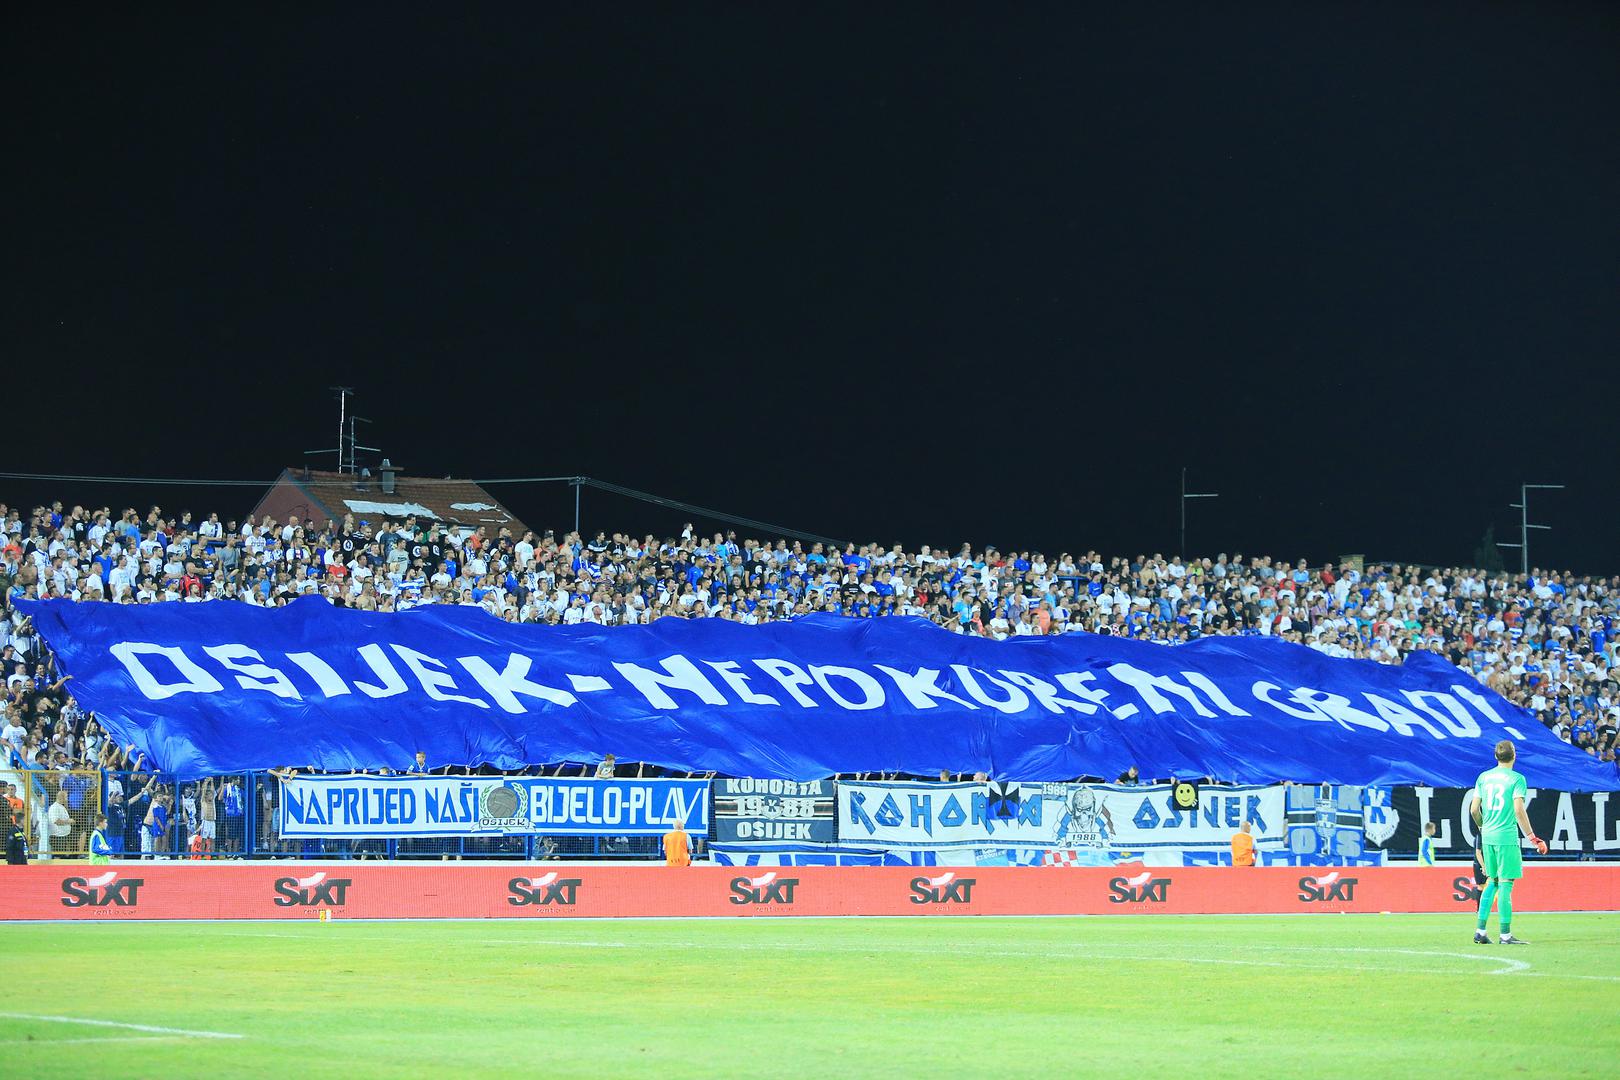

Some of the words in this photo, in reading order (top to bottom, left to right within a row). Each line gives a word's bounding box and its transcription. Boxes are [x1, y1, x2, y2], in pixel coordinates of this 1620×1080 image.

[109, 641, 578, 714] OSIJEK
[1252, 680, 1526, 740] GRAD!
[286, 787, 416, 824] NAPRIJED
[425, 782, 479, 823] NAŠI
[530, 786, 709, 824] BIJELO-PLAVI
[1415, 786, 1620, 850] LAL
[1485, 784, 1505, 810] 13
[736, 821, 811, 839] OSIJEK
